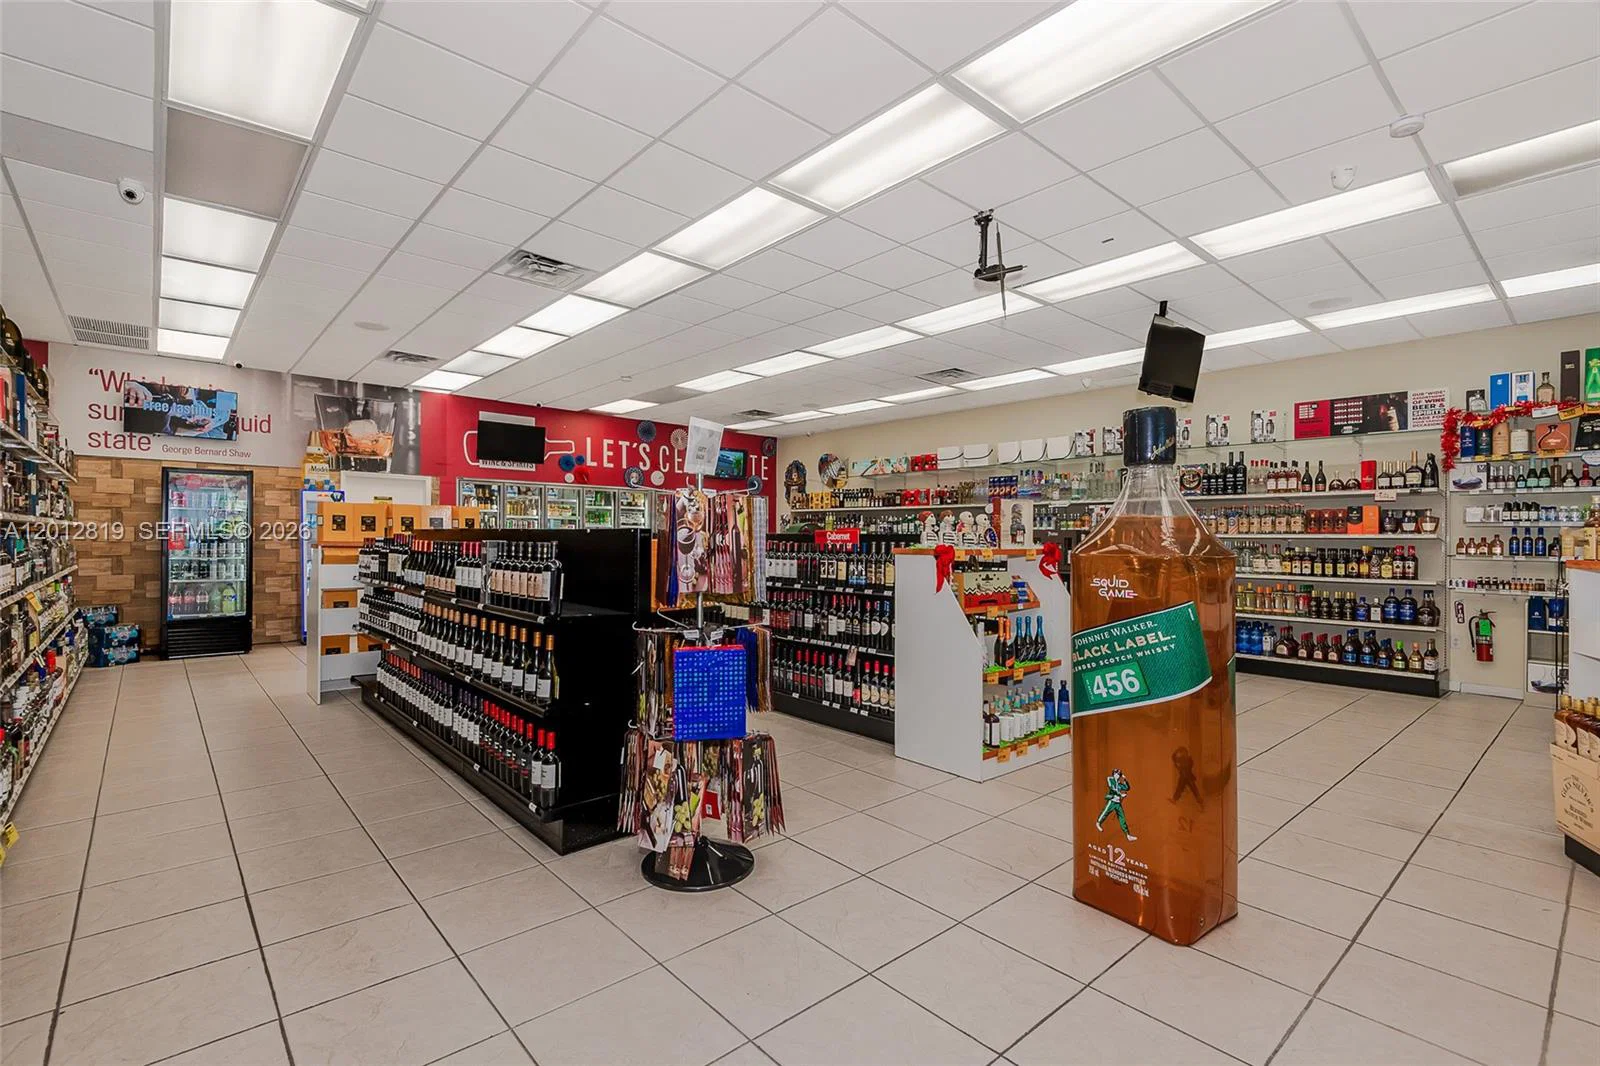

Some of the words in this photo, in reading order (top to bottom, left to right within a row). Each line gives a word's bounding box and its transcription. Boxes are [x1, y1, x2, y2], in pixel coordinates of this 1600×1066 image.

[162, 444, 192, 456] George
[195, 446, 227, 457] Bernard
[229, 448, 251, 458] Shaw
[586, 437, 650, 471] LET'S
[1090, 575, 1129, 590] SQUID
[1098, 588, 1138, 600] GAME
[1072, 644, 1111, 662] BLACK
[1114, 631, 1171, 652] LABEL
[1075, 631, 1110, 649] JOHNNIE
[1111, 620, 1155, 637] WALKER
[1100, 654, 1133, 666] SCOTCH
[1136, 643, 1176, 657] WHISKY
[1093, 669, 1141, 698] 456
[1088, 843, 1107, 854] AGED
[1107, 844, 1126, 867] 12
[1126, 857, 1149, 870] YEARS
